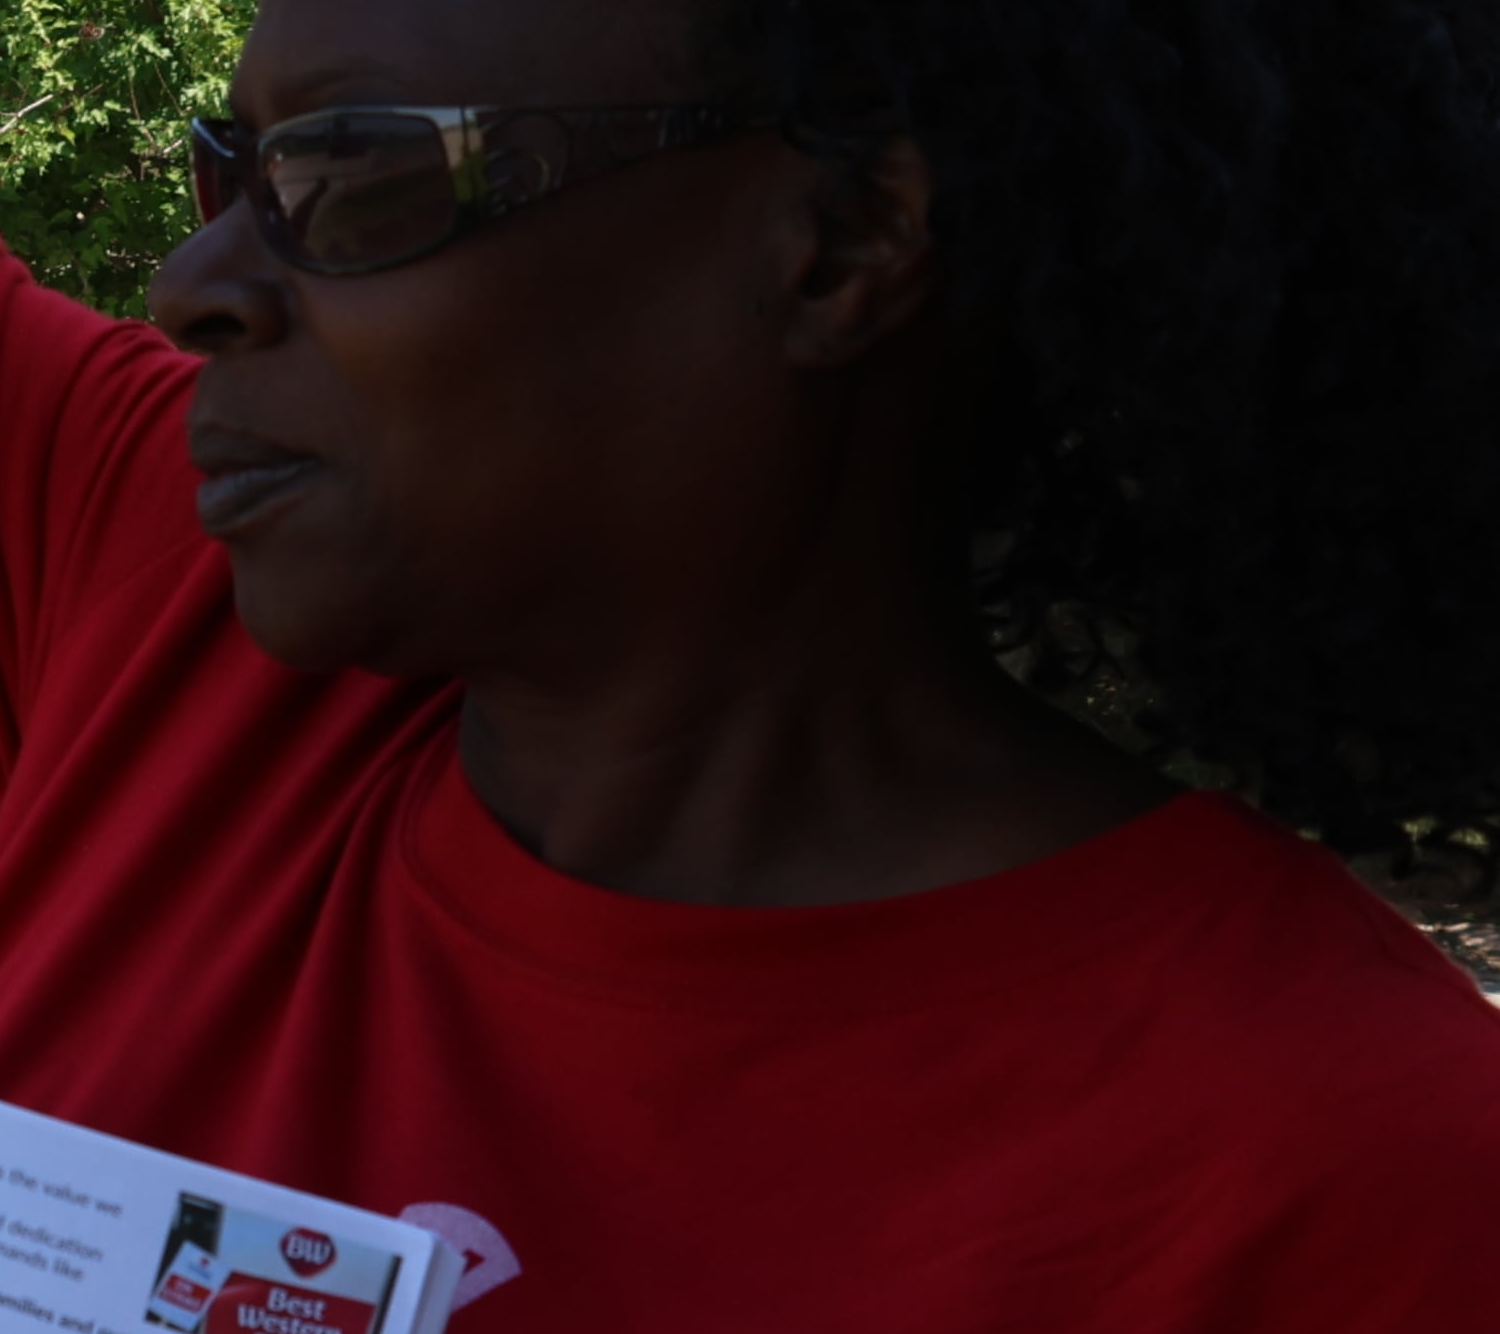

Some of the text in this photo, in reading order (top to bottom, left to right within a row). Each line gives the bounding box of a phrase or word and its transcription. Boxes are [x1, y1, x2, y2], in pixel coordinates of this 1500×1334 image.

[8, 1169, 38, 1189] the
[42, 1184, 91, 1206] value
[94, 1200, 123, 1216] we
[7, 1221, 103, 1261] dedication
[285, 1232, 332, 1265] BW
[51, 1259, 83, 1280] like
[268, 1286, 327, 1321] Best
[57, 1315, 94, 1334] and
